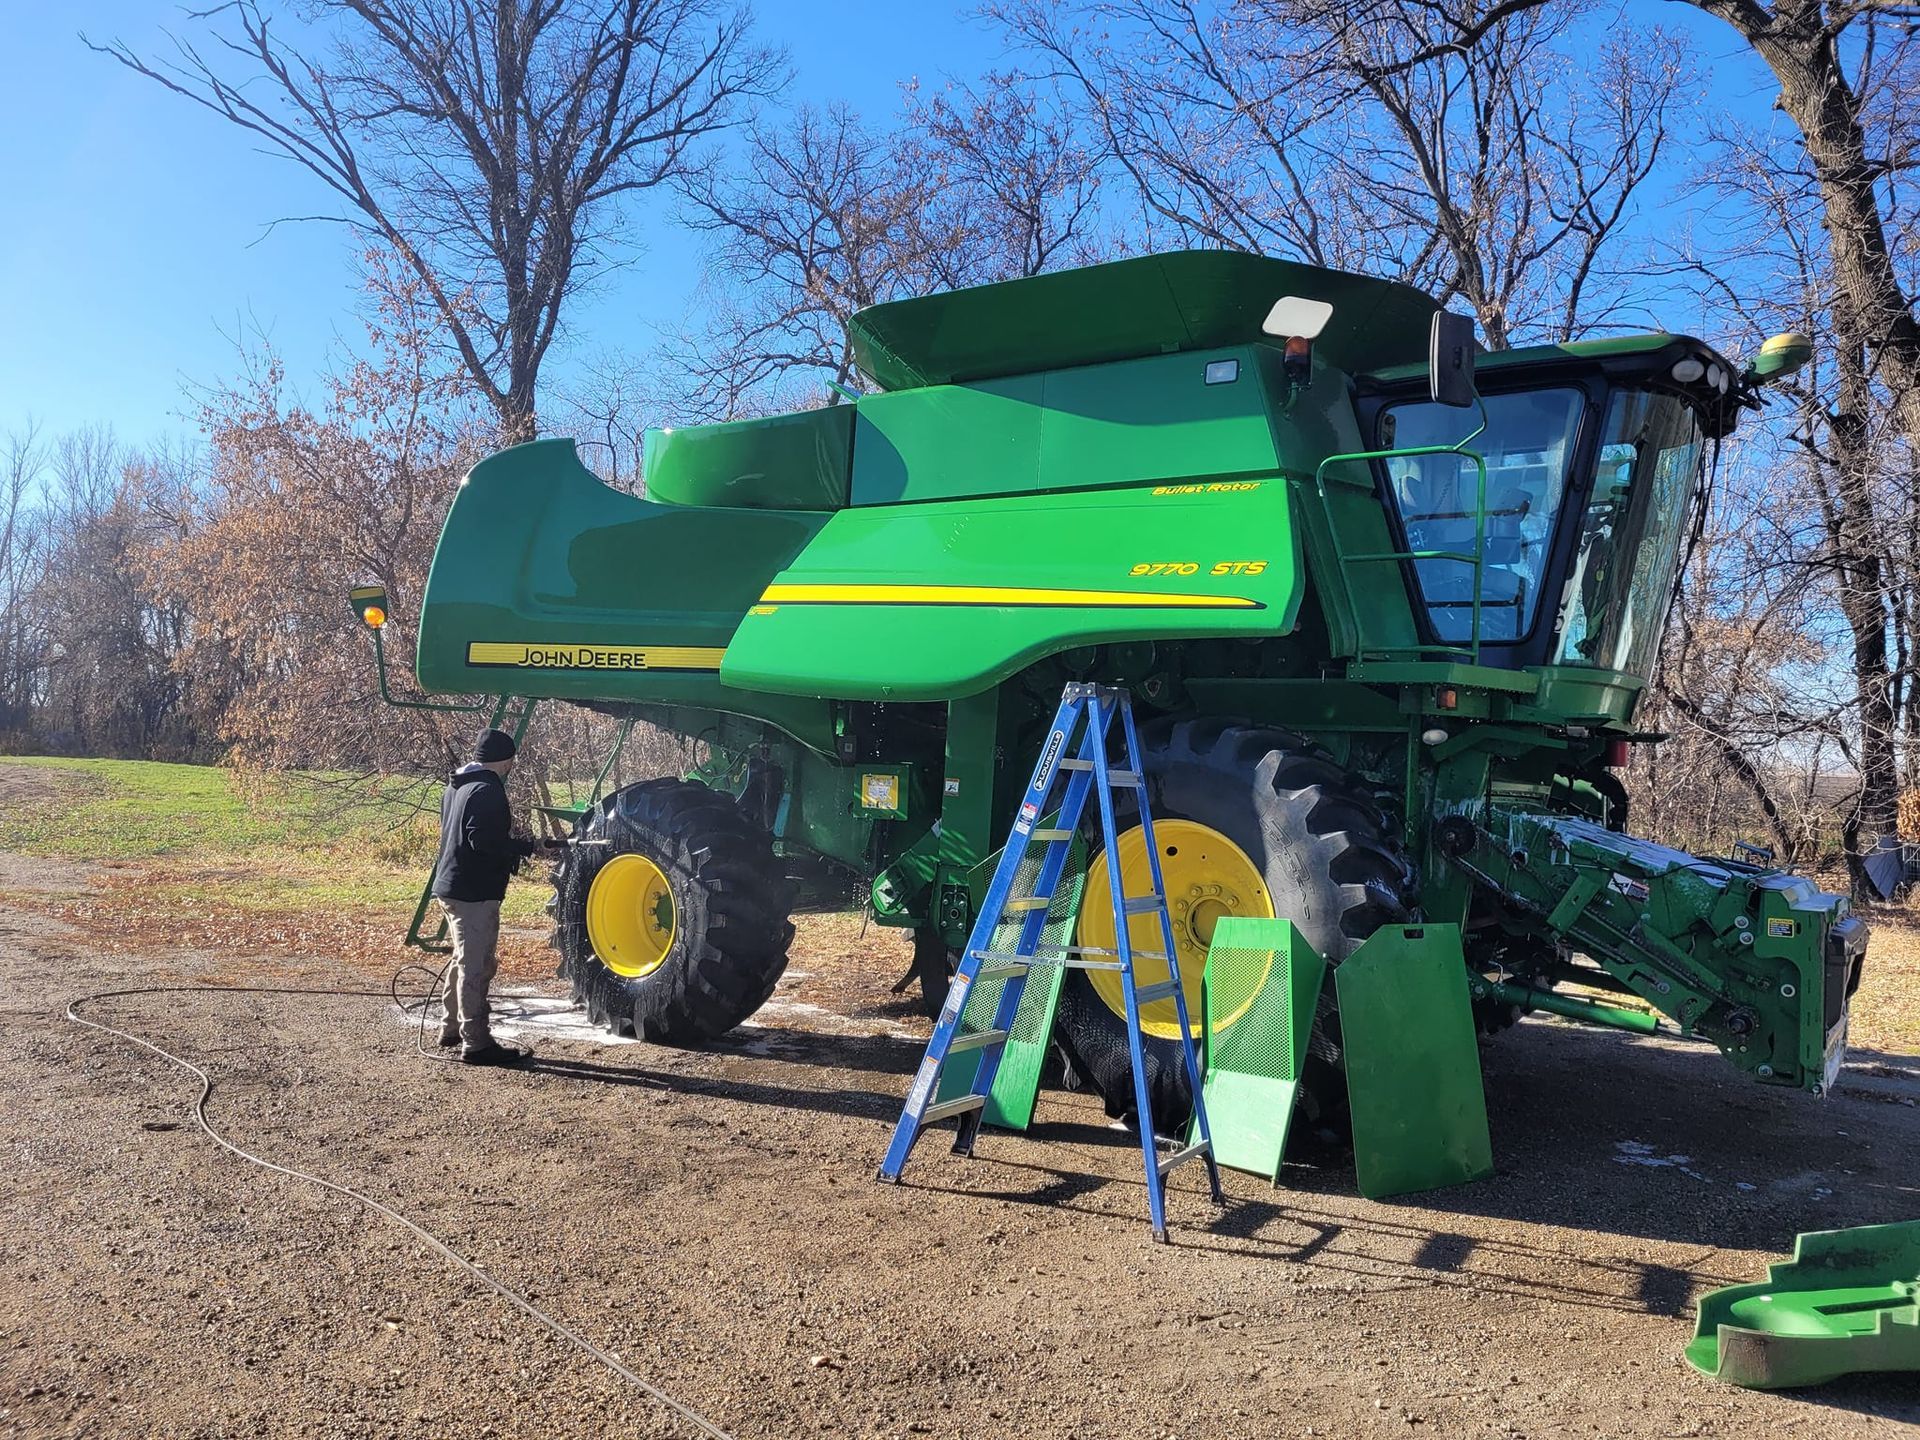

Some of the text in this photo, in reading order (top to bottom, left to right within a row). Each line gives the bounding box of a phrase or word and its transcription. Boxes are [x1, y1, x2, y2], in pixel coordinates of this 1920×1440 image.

[1151, 483, 1261, 496] Bullet Rotor
[1129, 560, 1269, 576] 9770 STS
[518, 647, 646, 667] JOHN DEERE
[1039, 732, 1062, 781] LOUISVILLE
